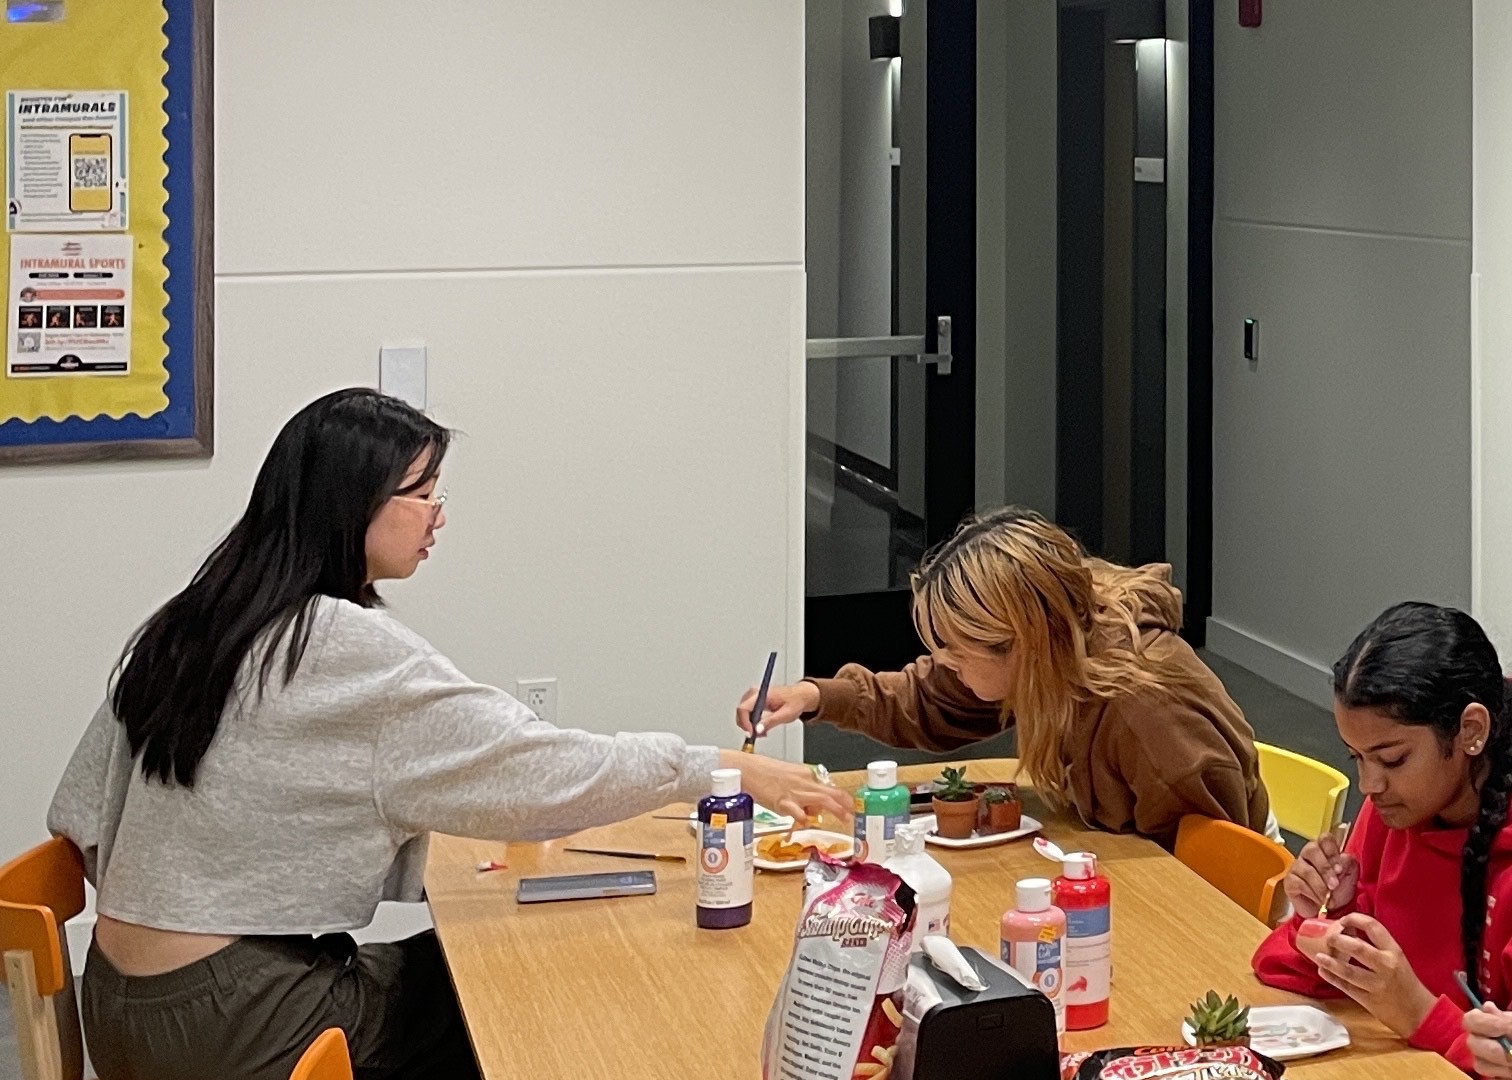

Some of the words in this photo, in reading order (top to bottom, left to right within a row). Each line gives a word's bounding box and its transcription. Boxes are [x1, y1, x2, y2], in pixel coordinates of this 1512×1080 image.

[18, 102, 116, 114] INTRAMURALS
[20, 258, 86, 269] INTRAMURAL
[89, 258, 126, 269] SPORTS
